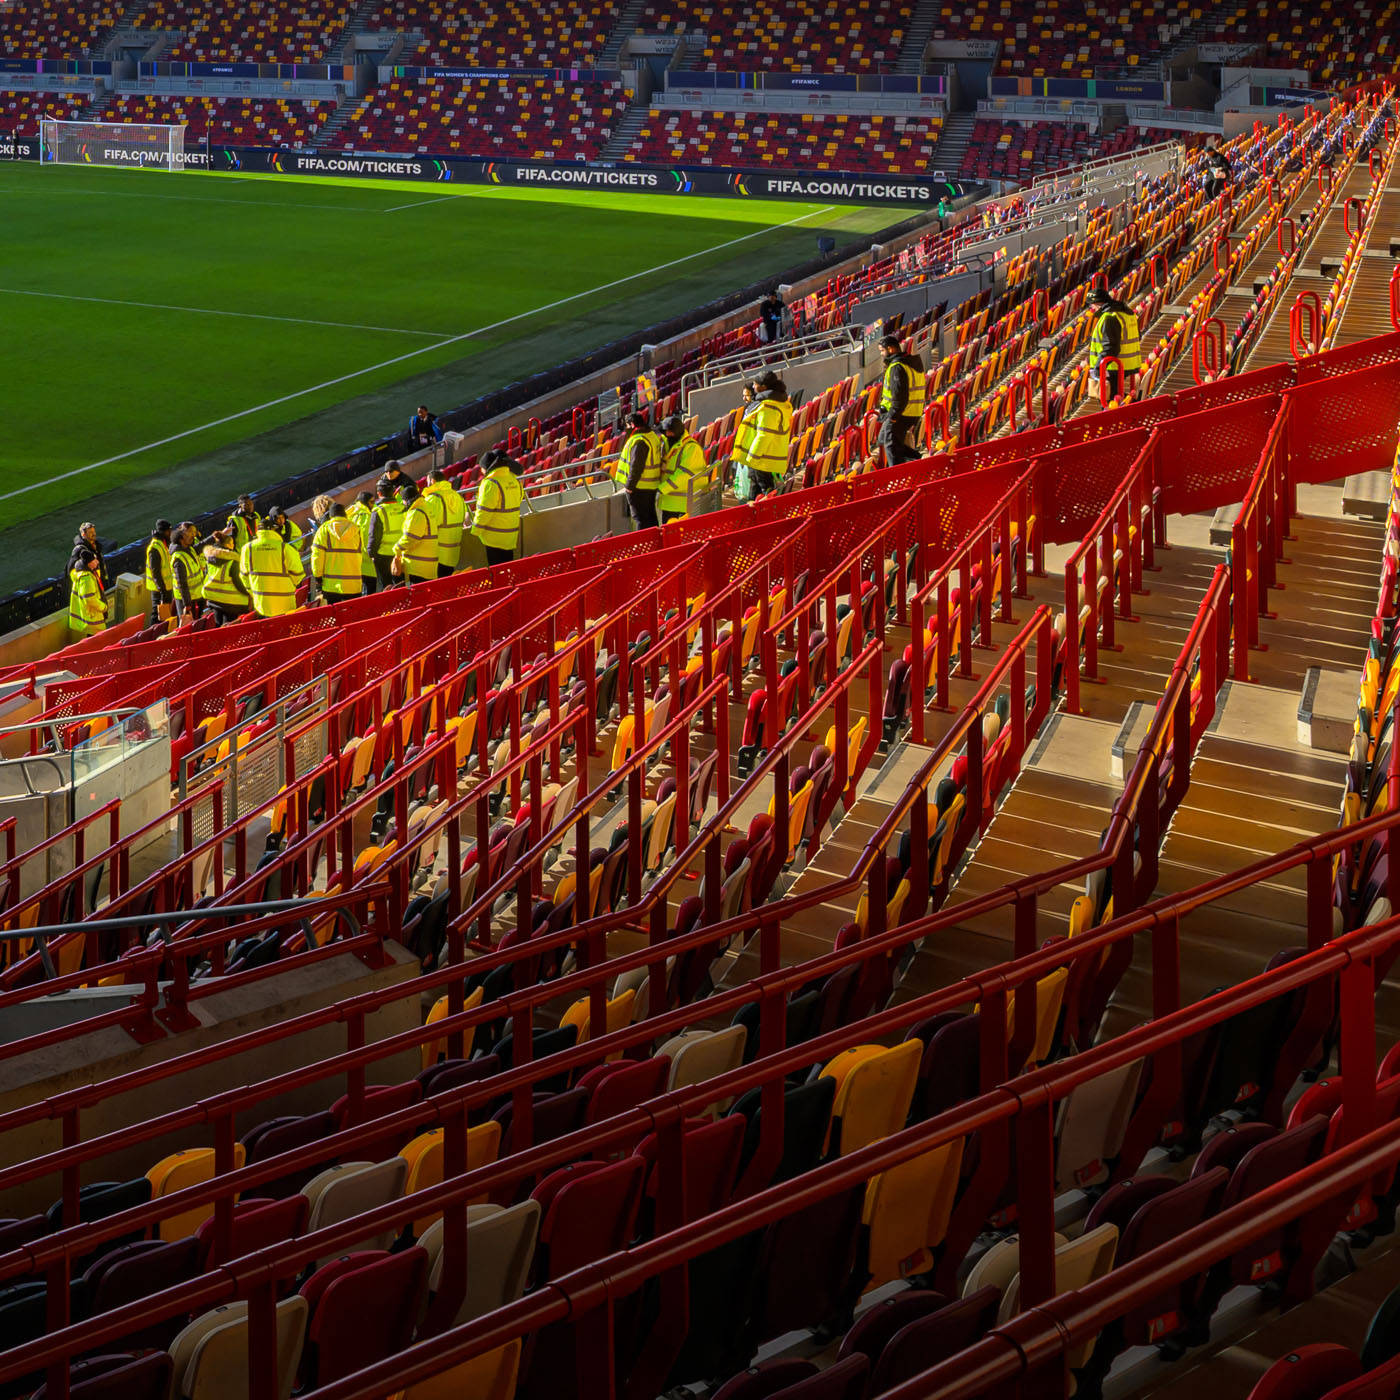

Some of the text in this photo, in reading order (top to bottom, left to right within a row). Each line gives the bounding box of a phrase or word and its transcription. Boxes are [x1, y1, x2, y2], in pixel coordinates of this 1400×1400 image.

[297, 157, 422, 175] FIFA.COM/TICKETS
[516, 167, 657, 186] FIFA.COM/TICKETS
[767, 179, 930, 199] FIFA.COM/TICKETS
